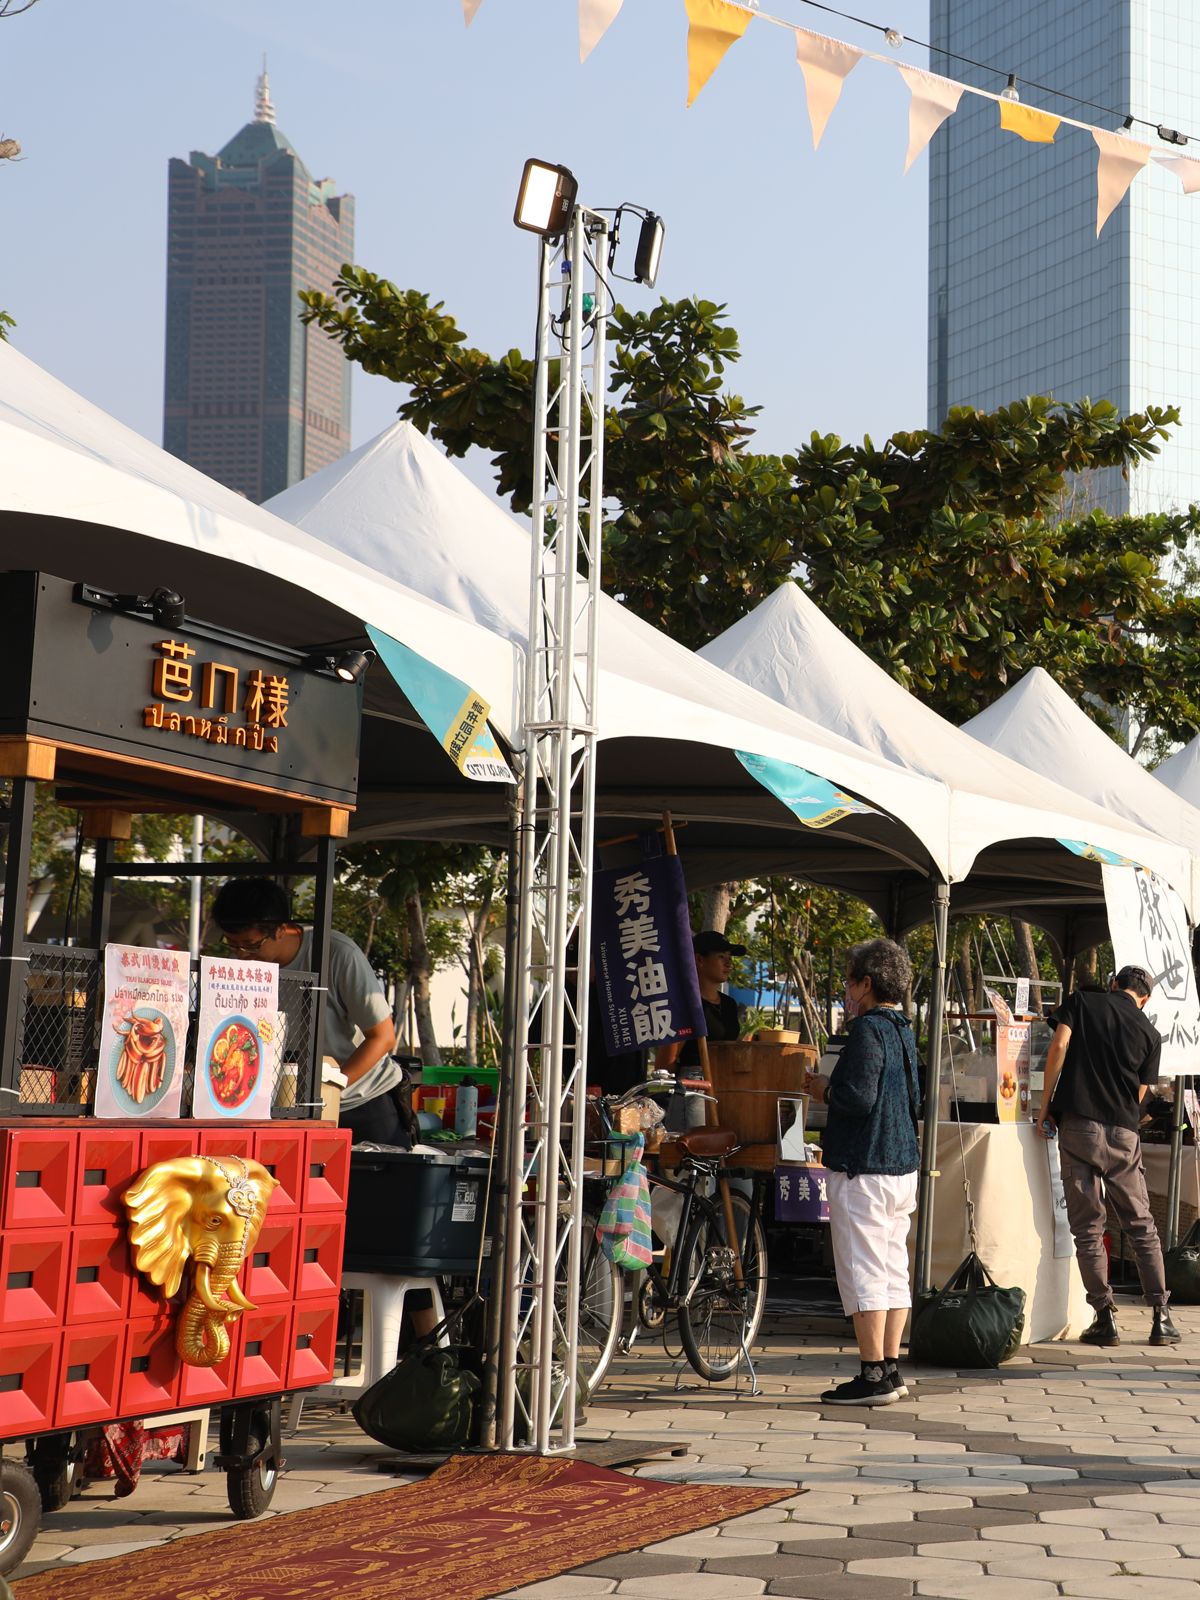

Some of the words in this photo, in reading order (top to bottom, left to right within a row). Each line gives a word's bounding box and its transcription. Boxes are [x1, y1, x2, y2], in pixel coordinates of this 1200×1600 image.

[466, 763, 487, 776] CITY
[613, 871, 677, 1045] 秀美油飯
